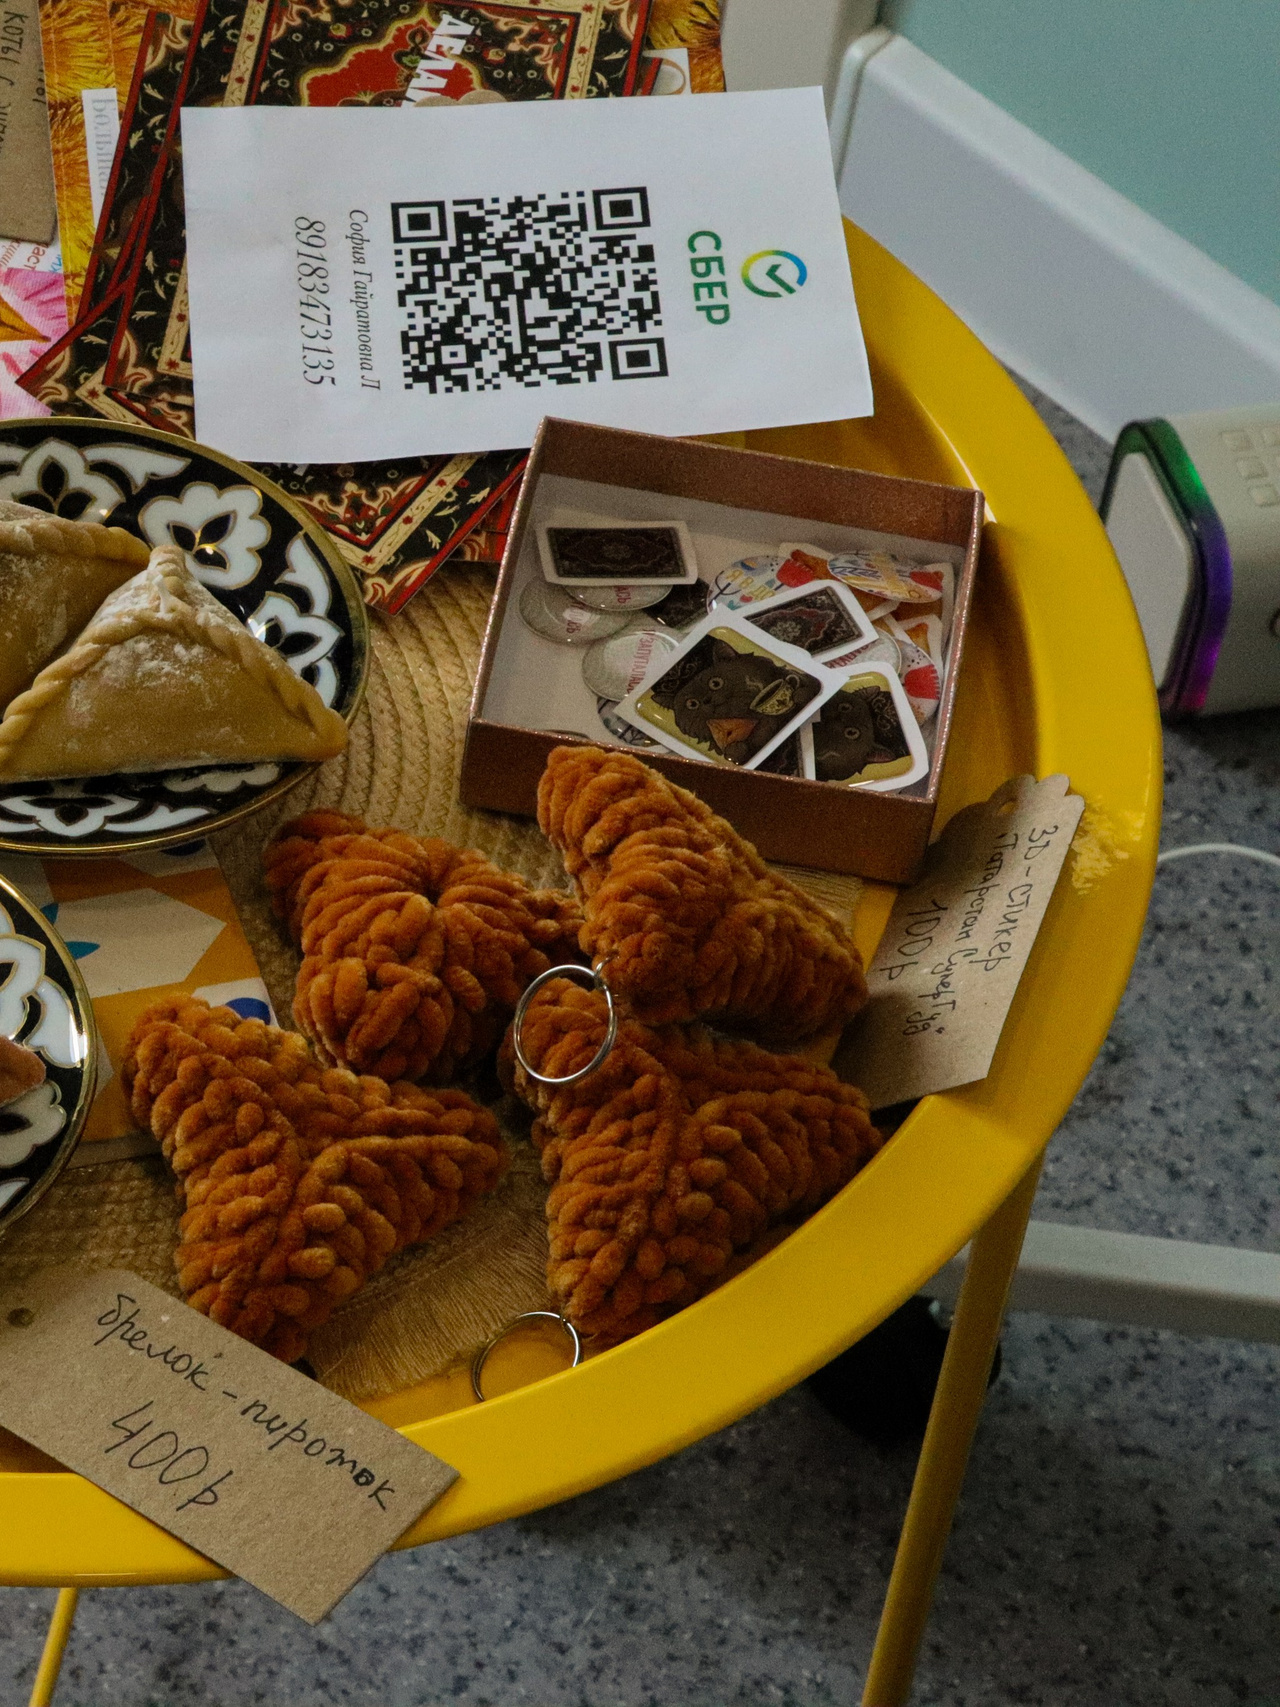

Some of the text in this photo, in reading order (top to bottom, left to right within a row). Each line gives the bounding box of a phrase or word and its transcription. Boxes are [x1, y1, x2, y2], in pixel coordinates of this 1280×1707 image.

[294, 216, 337, 386] 89183473135
[345, 209, 381, 391] София Гайратовна Л
[687, 230, 731, 325] СБЕР
